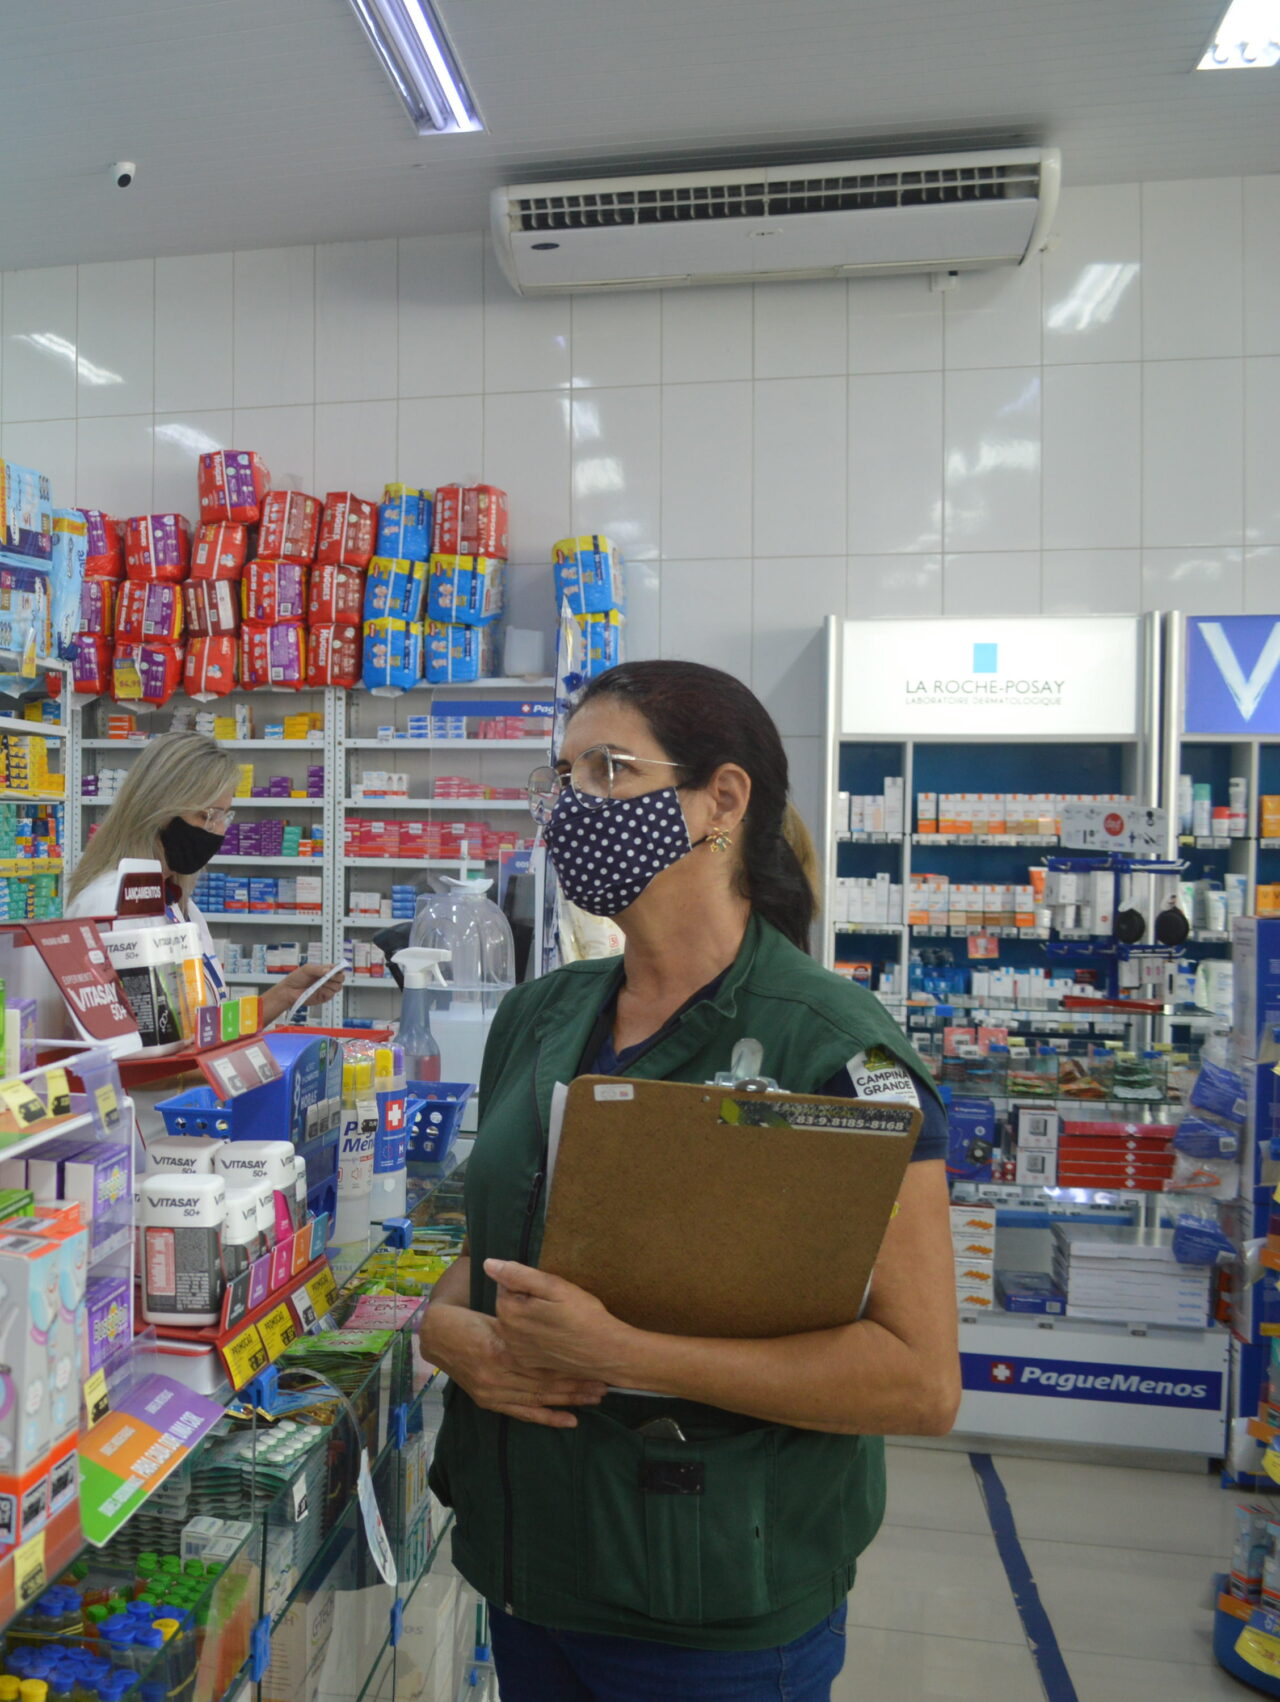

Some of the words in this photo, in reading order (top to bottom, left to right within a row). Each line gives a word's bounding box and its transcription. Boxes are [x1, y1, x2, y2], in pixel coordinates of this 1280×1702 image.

[905, 680, 928, 695] LA
[933, 680, 1066, 695] ROCHE-POSAY
[124, 885, 162, 903] LANÇAMENTOS
[125, 952, 140, 960] 50+
[67, 982, 119, 1012] VITASAY
[110, 1004, 128, 1022] 50+
[856, 1069, 909, 1088] CAMPINA
[862, 1080, 913, 1097] GRANDE
[151, 1154, 198, 1168] VITASAY
[221, 1158, 268, 1170] VITASAY
[252, 1169, 269, 1178] 50+
[146, 1196, 201, 1209] VITASAY
[183, 1208, 201, 1217] 50+
[373, 1303, 408, 1312] ENO
[1020, 1366, 1208, 1399] PagueMenos
